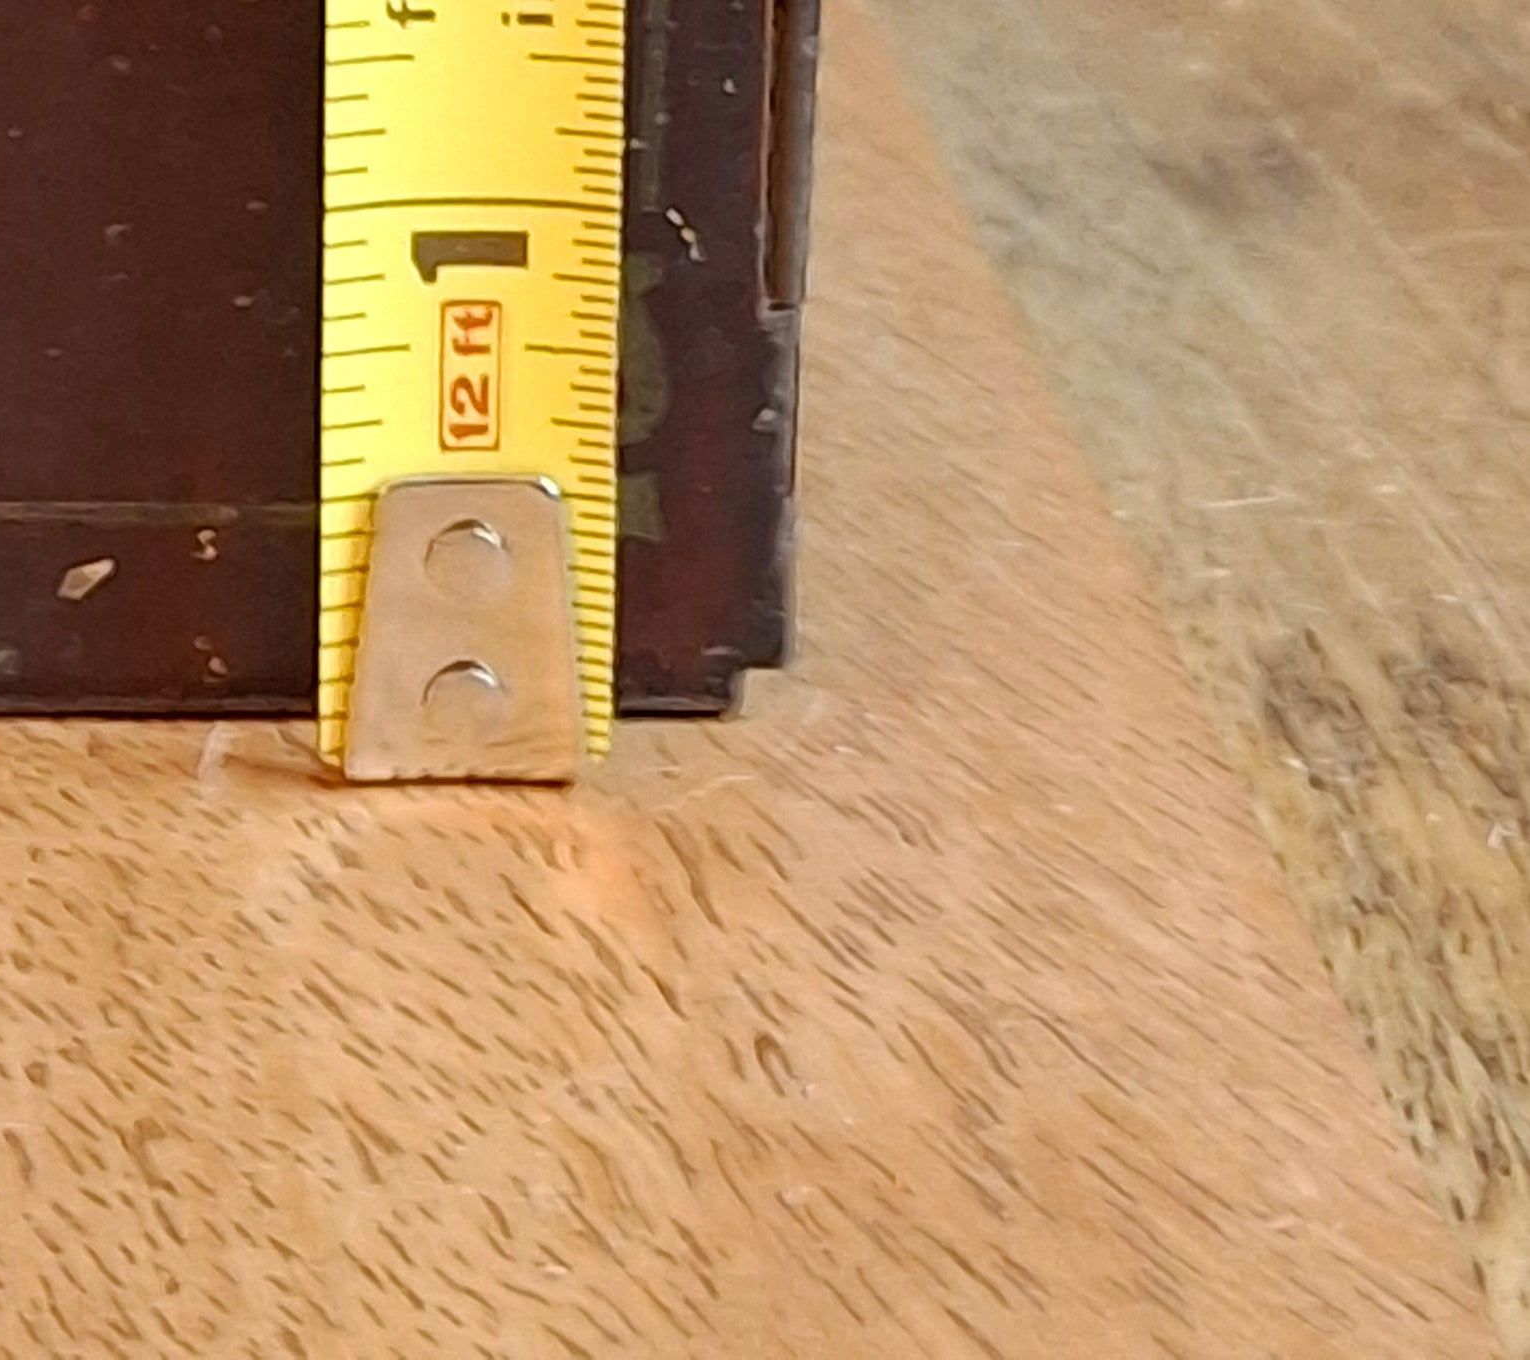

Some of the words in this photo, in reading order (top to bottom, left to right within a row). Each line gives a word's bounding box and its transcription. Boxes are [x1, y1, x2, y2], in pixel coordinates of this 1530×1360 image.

[410, 229, 529, 284] 1
[450, 304, 495, 357] ft
[449, 373, 492, 441] 12
